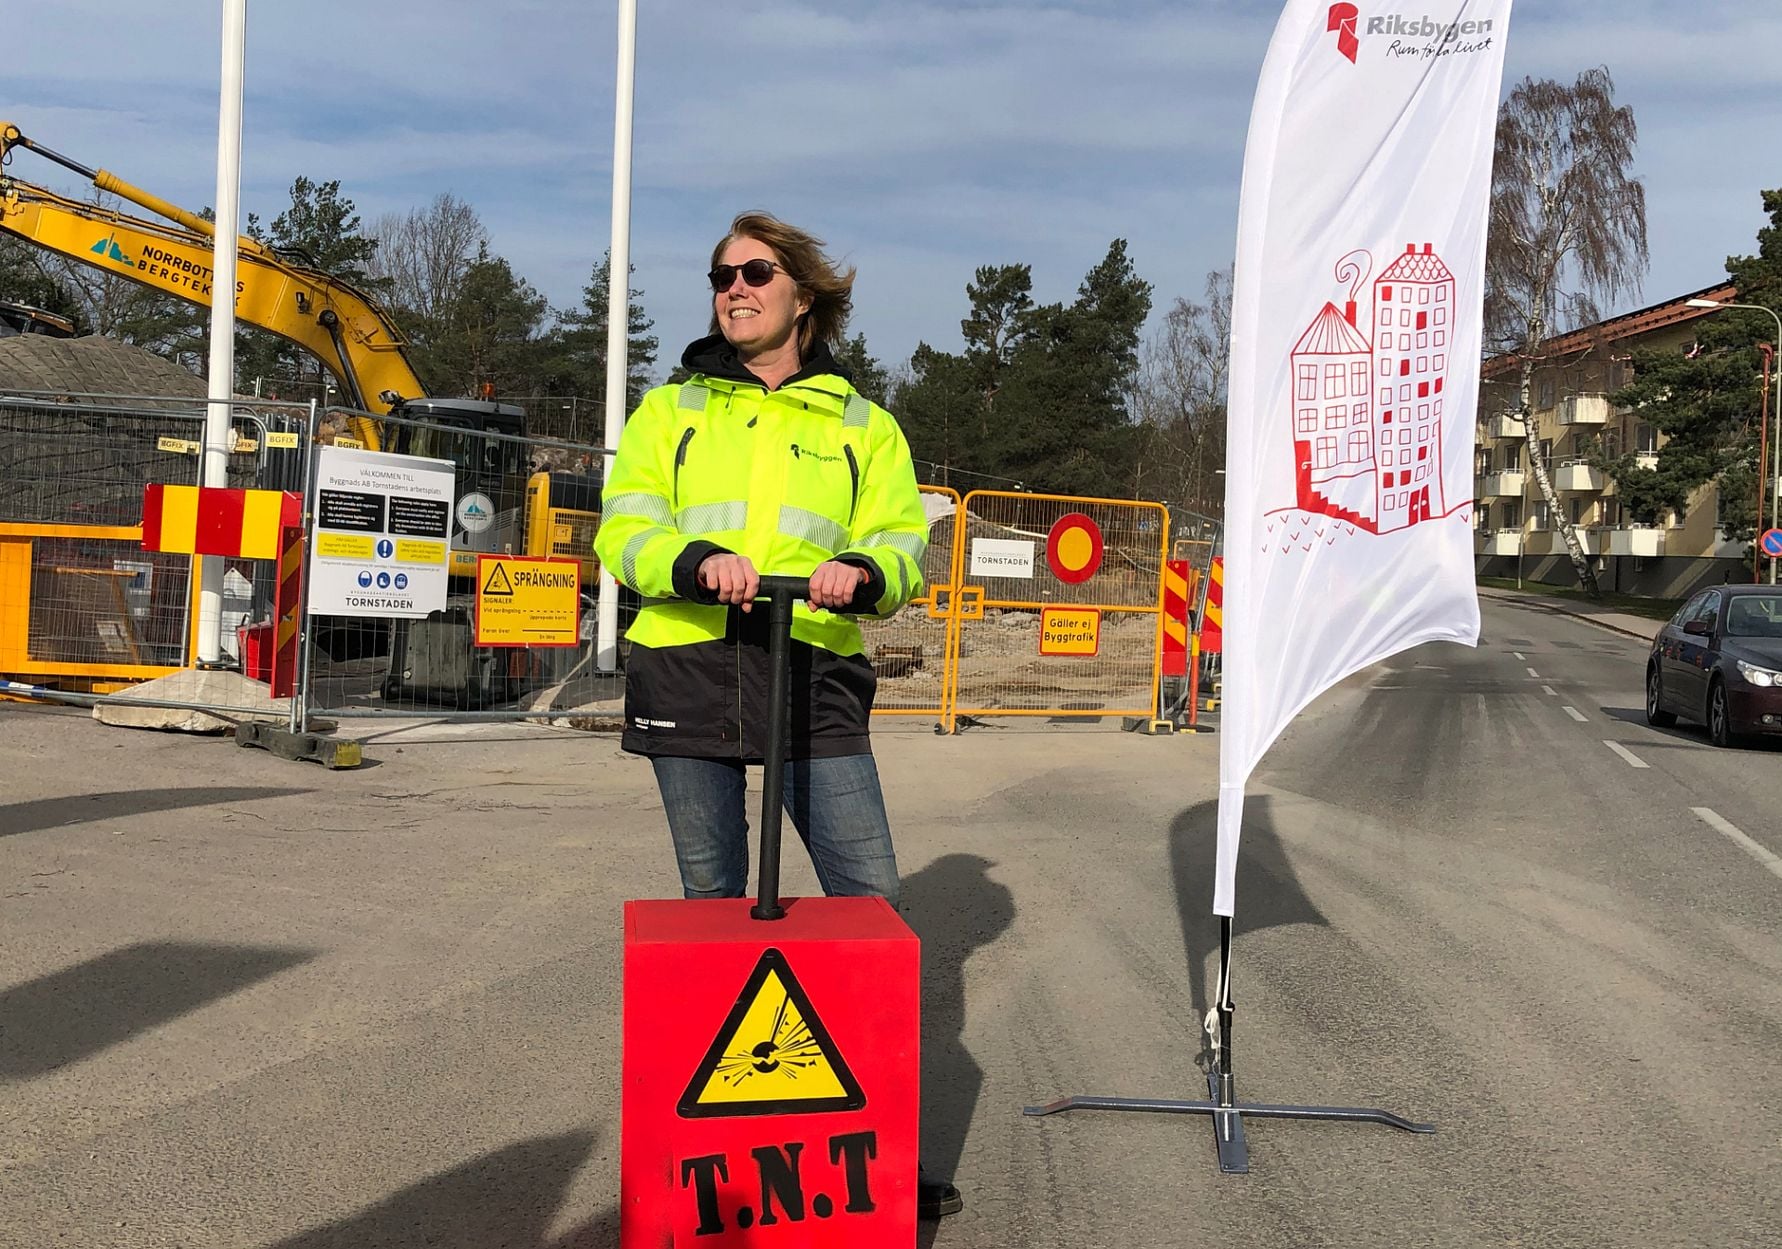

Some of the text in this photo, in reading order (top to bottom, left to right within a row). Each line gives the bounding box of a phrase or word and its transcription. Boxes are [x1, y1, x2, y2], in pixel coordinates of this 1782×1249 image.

[1386, 39, 1419, 58] Rum
[142, 245, 245, 293] NORRBOTTS
[269, 435, 295, 444] BGFIX
[402, 473, 414, 482] TILL
[329, 476, 442, 496] Byggnads AB Tornstadens arbetsplats
[977, 556, 1029, 566] TORNSTADEN
[514, 567, 575, 589] SPRÄNGNING
[345, 597, 413, 609] TORNSTADEN
[1049, 618, 1091, 630] Gäller ej
[1044, 631, 1094, 644] Byggtrafik
[681, 1131, 877, 1236] T.N.T
